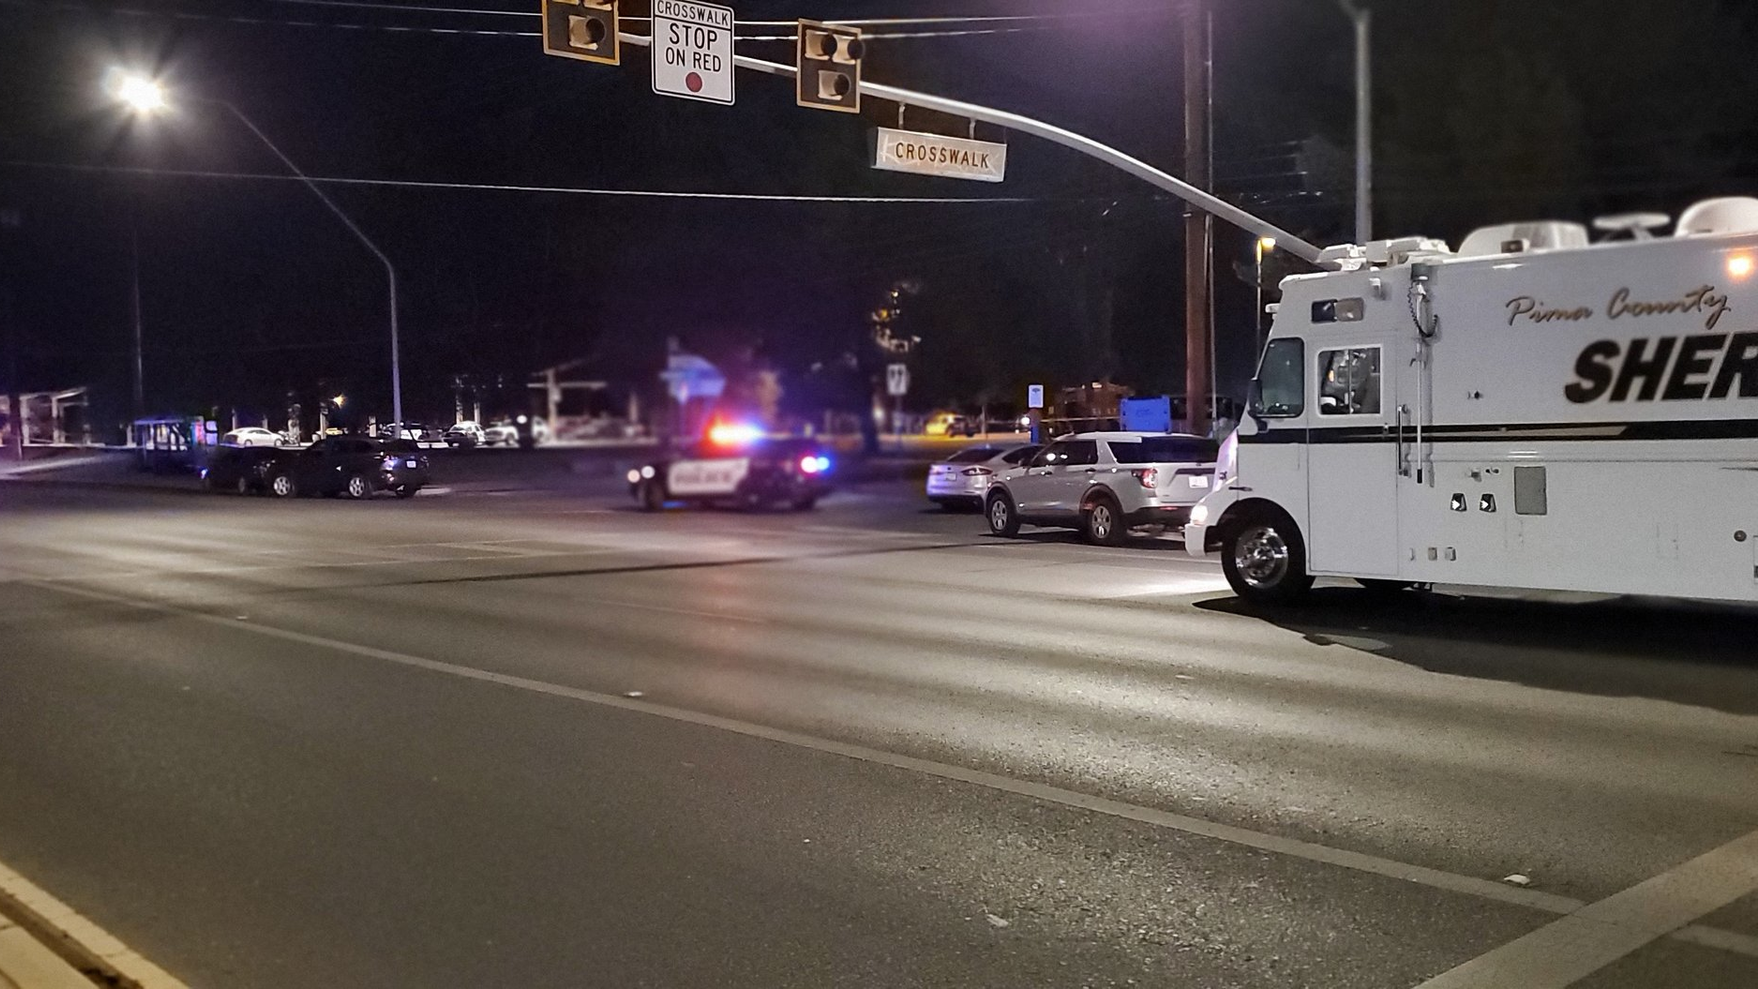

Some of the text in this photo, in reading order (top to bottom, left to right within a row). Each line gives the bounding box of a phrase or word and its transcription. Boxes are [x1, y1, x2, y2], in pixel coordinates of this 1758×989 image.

[657, 0, 729, 27] CROSSWALK
[669, 22, 718, 51] STOP
[665, 47, 722, 73] ON RED
[895, 142, 990, 169] CROSSWALK
[1505, 284, 1732, 331] Pima County
[1564, 331, 1758, 405] SHER
